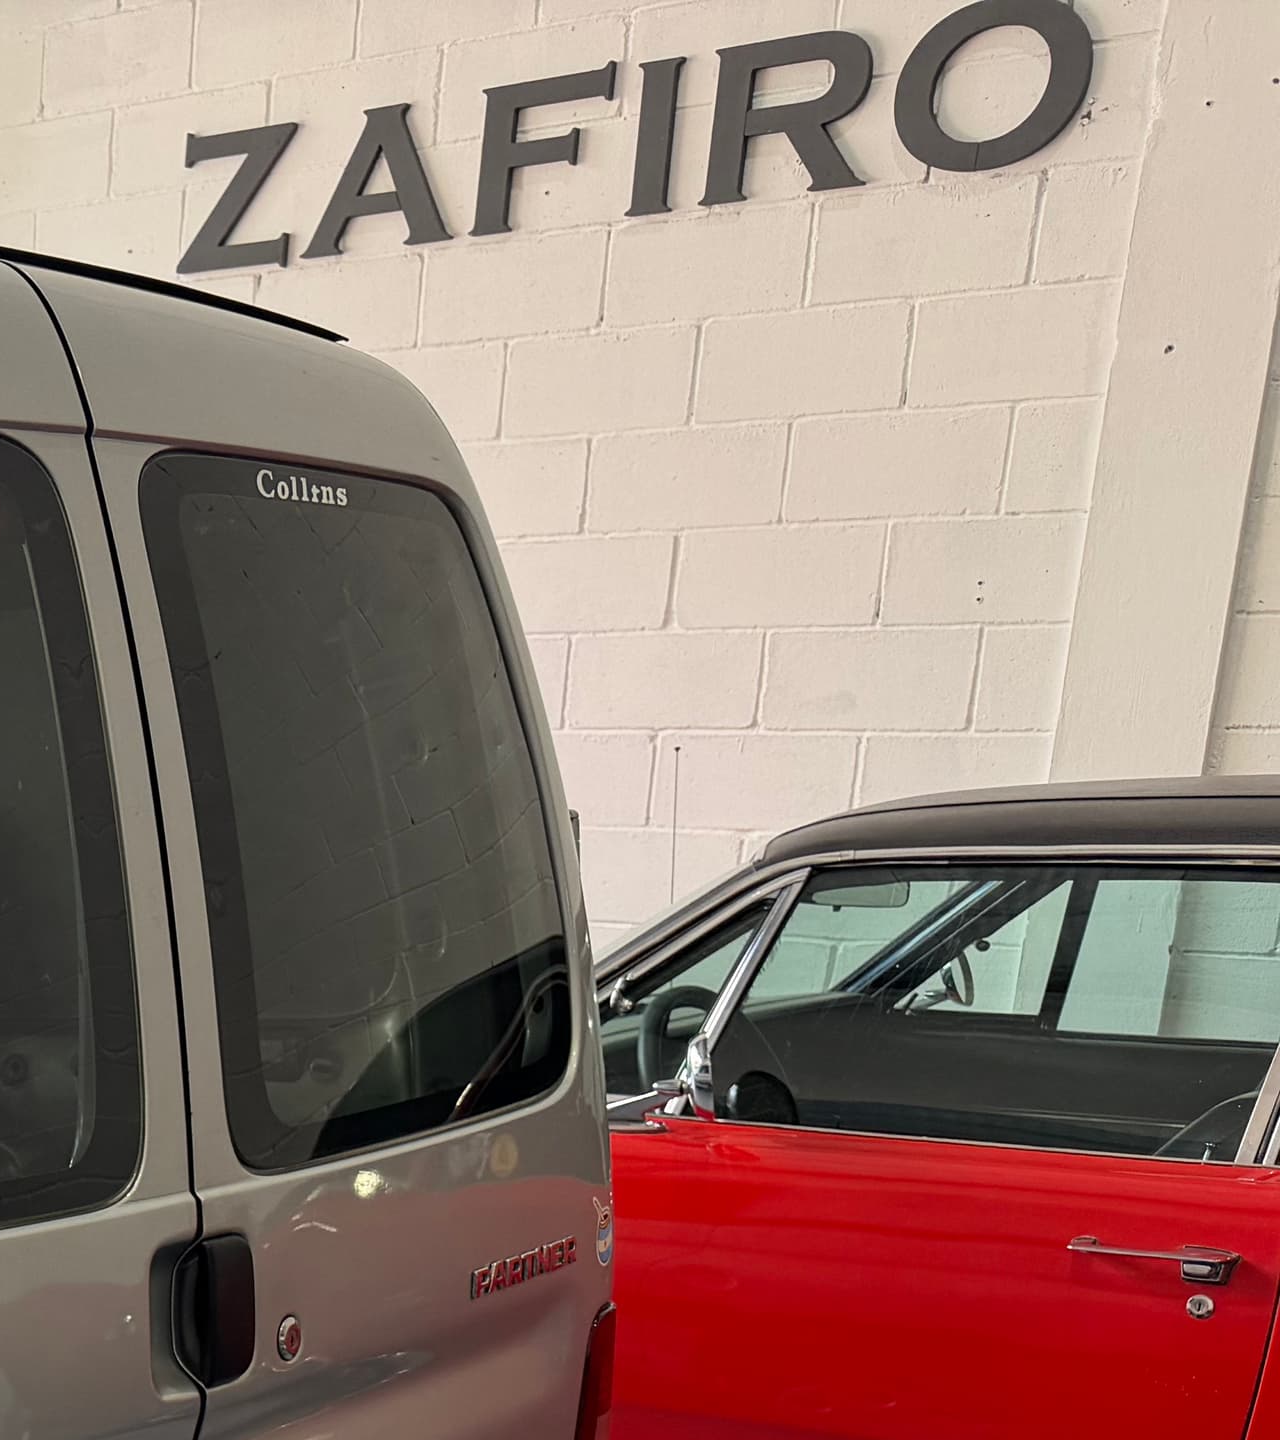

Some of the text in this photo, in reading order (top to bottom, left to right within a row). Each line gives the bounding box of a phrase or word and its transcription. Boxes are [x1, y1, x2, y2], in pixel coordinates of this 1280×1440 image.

[175, 0, 1095, 276] ZAFIRO
[255, 469, 348, 507] Collins
[469, 1234, 577, 1300] PARTNER
